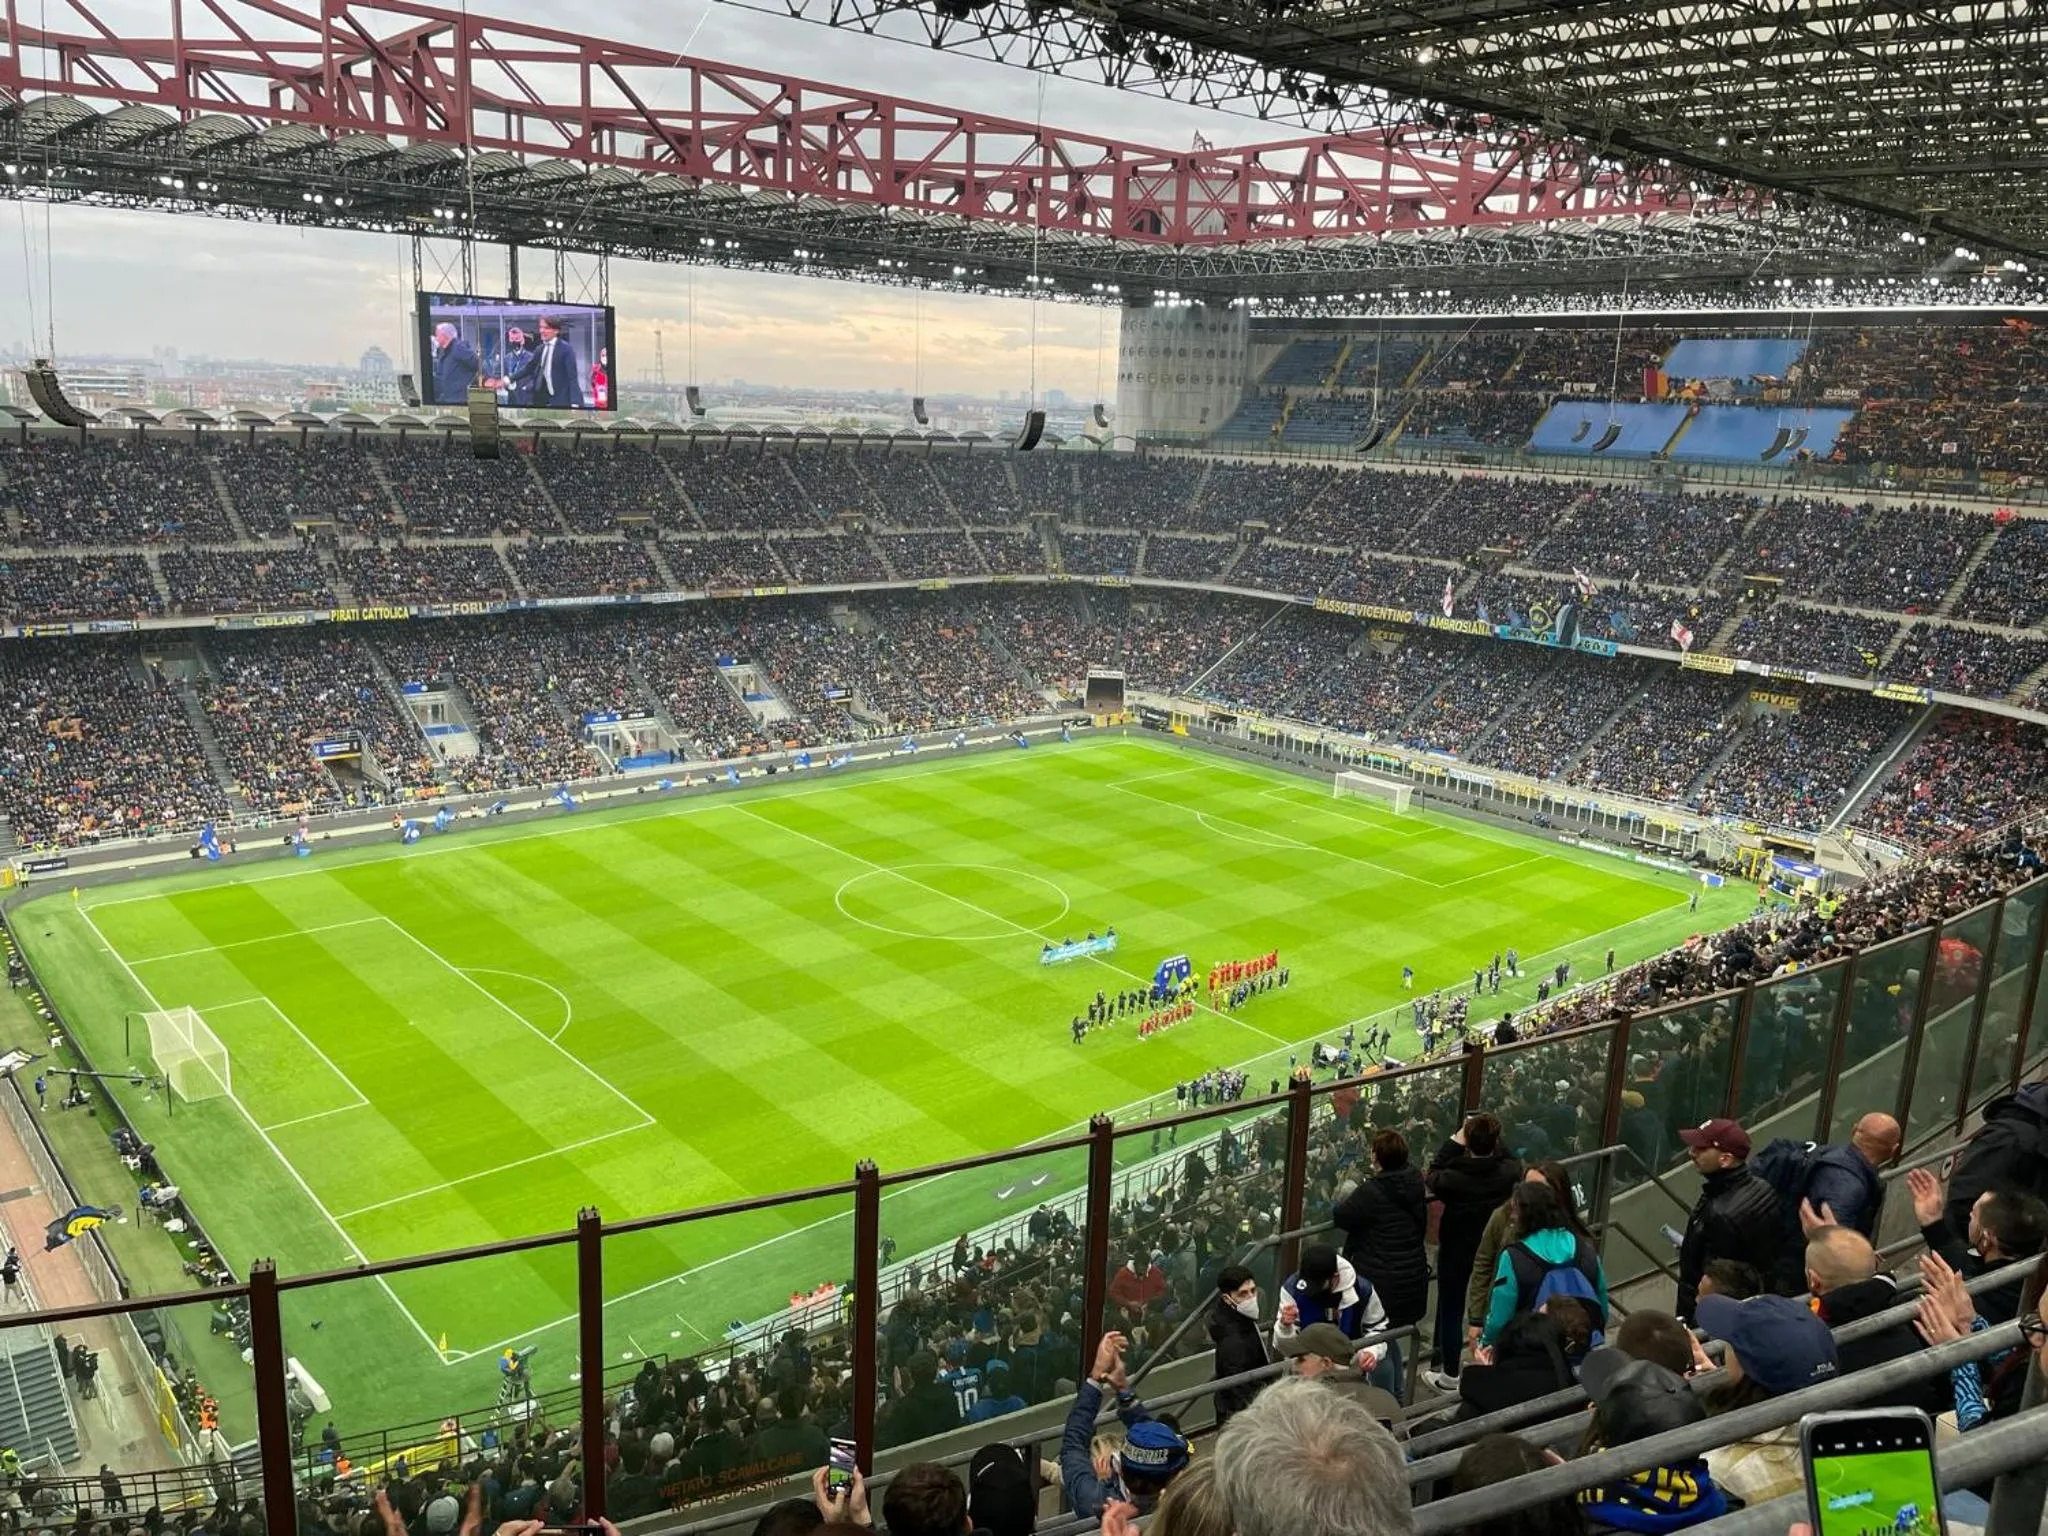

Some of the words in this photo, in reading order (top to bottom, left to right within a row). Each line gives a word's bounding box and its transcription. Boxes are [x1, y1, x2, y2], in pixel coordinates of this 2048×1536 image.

[331, 608, 360, 621] PIRATI
[362, 605, 409, 620] CATTOLICA
[1316, 599, 1348, 614] BASSO
[1356, 605, 1413, 623] VICENTINO
[954, 1388, 978, 1418] 10
[659, 1476, 713, 1498] VIETATO
